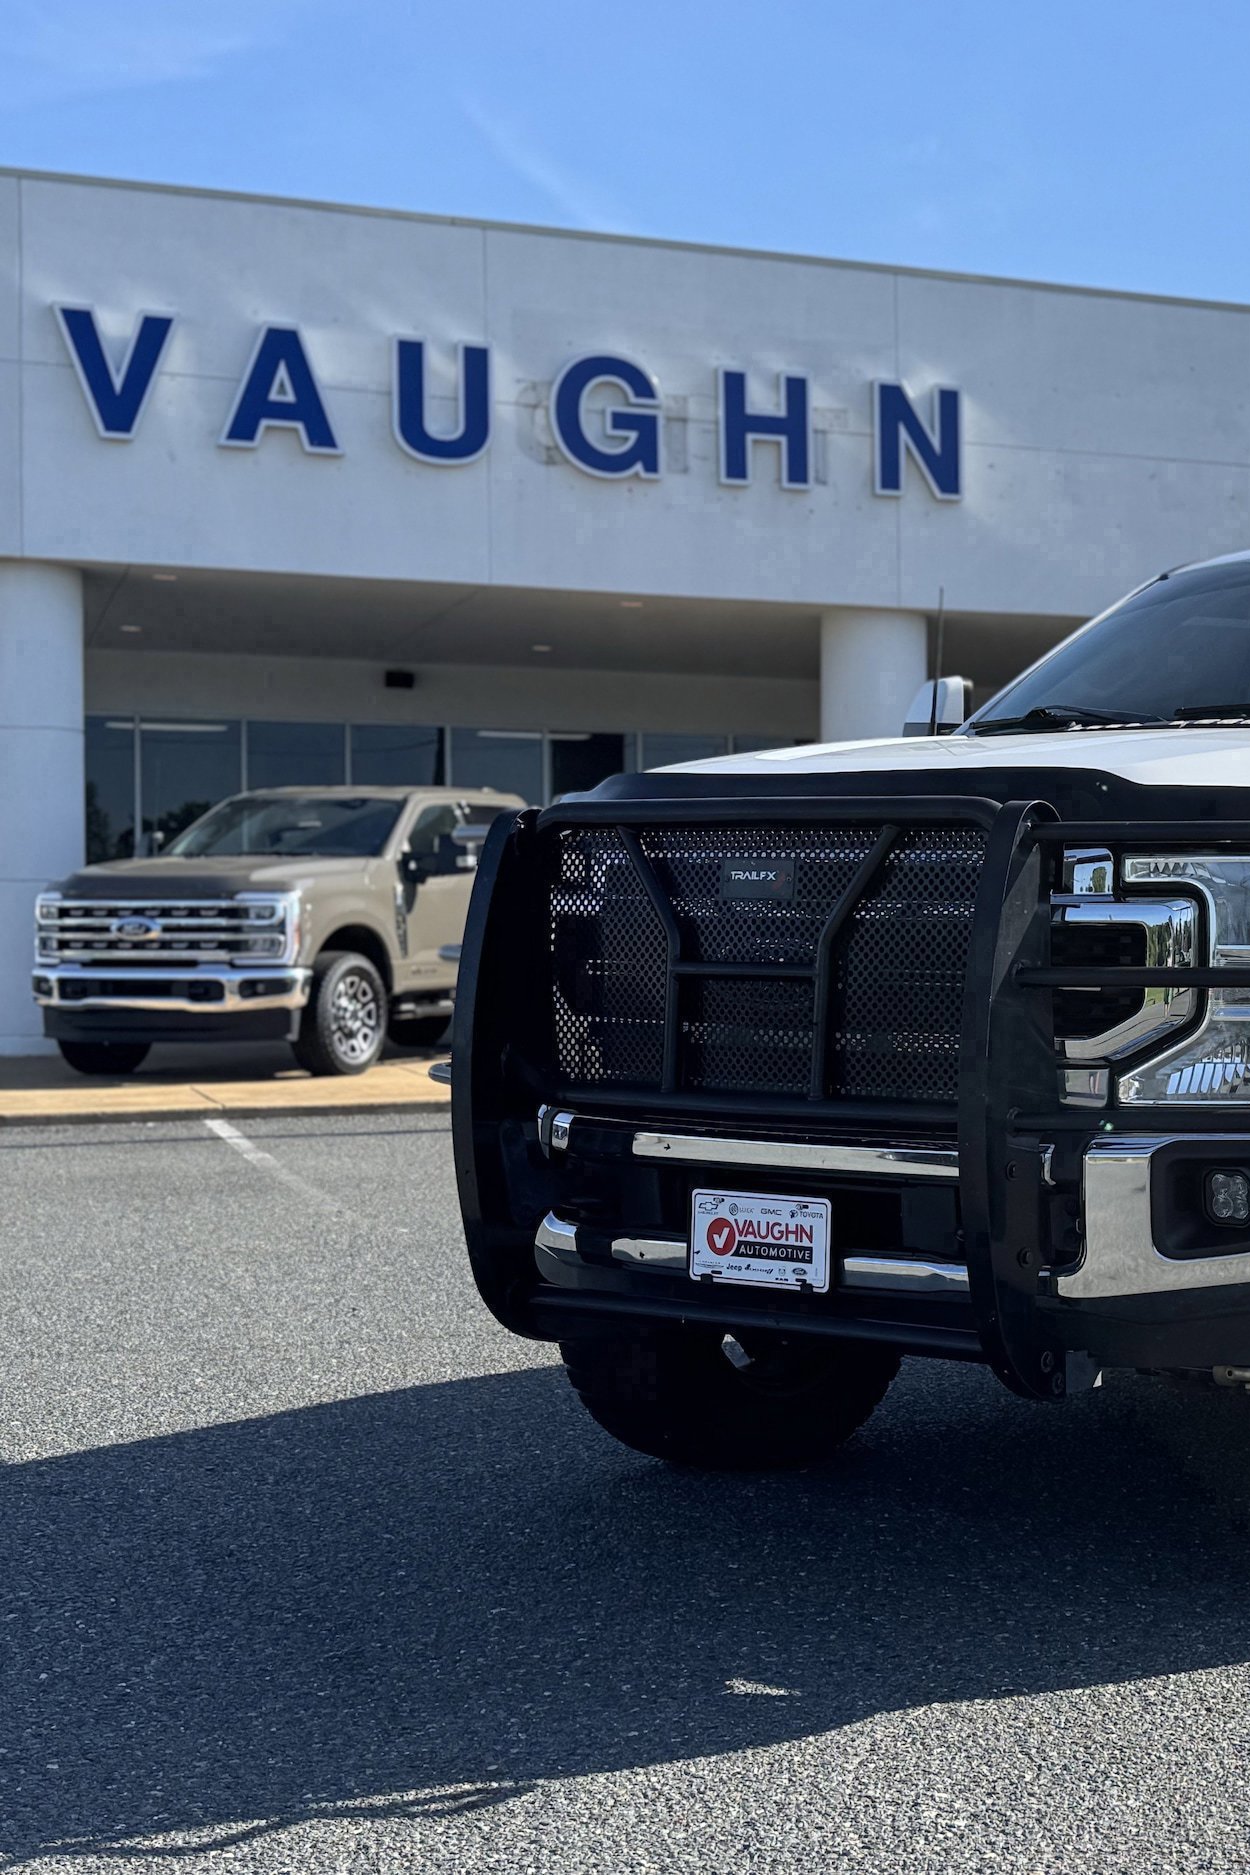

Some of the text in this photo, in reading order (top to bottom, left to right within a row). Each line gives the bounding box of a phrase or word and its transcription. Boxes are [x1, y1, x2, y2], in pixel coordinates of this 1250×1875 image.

[54, 303, 964, 501] VAUGHN
[760, 1208, 783, 1216] GMC
[798, 1210, 824, 1219] TOYOTA
[733, 1218, 814, 1244] VAUGHN
[739, 1244, 811, 1261] AUTOMOTIVE
[726, 1263, 743, 1272] Jeep
